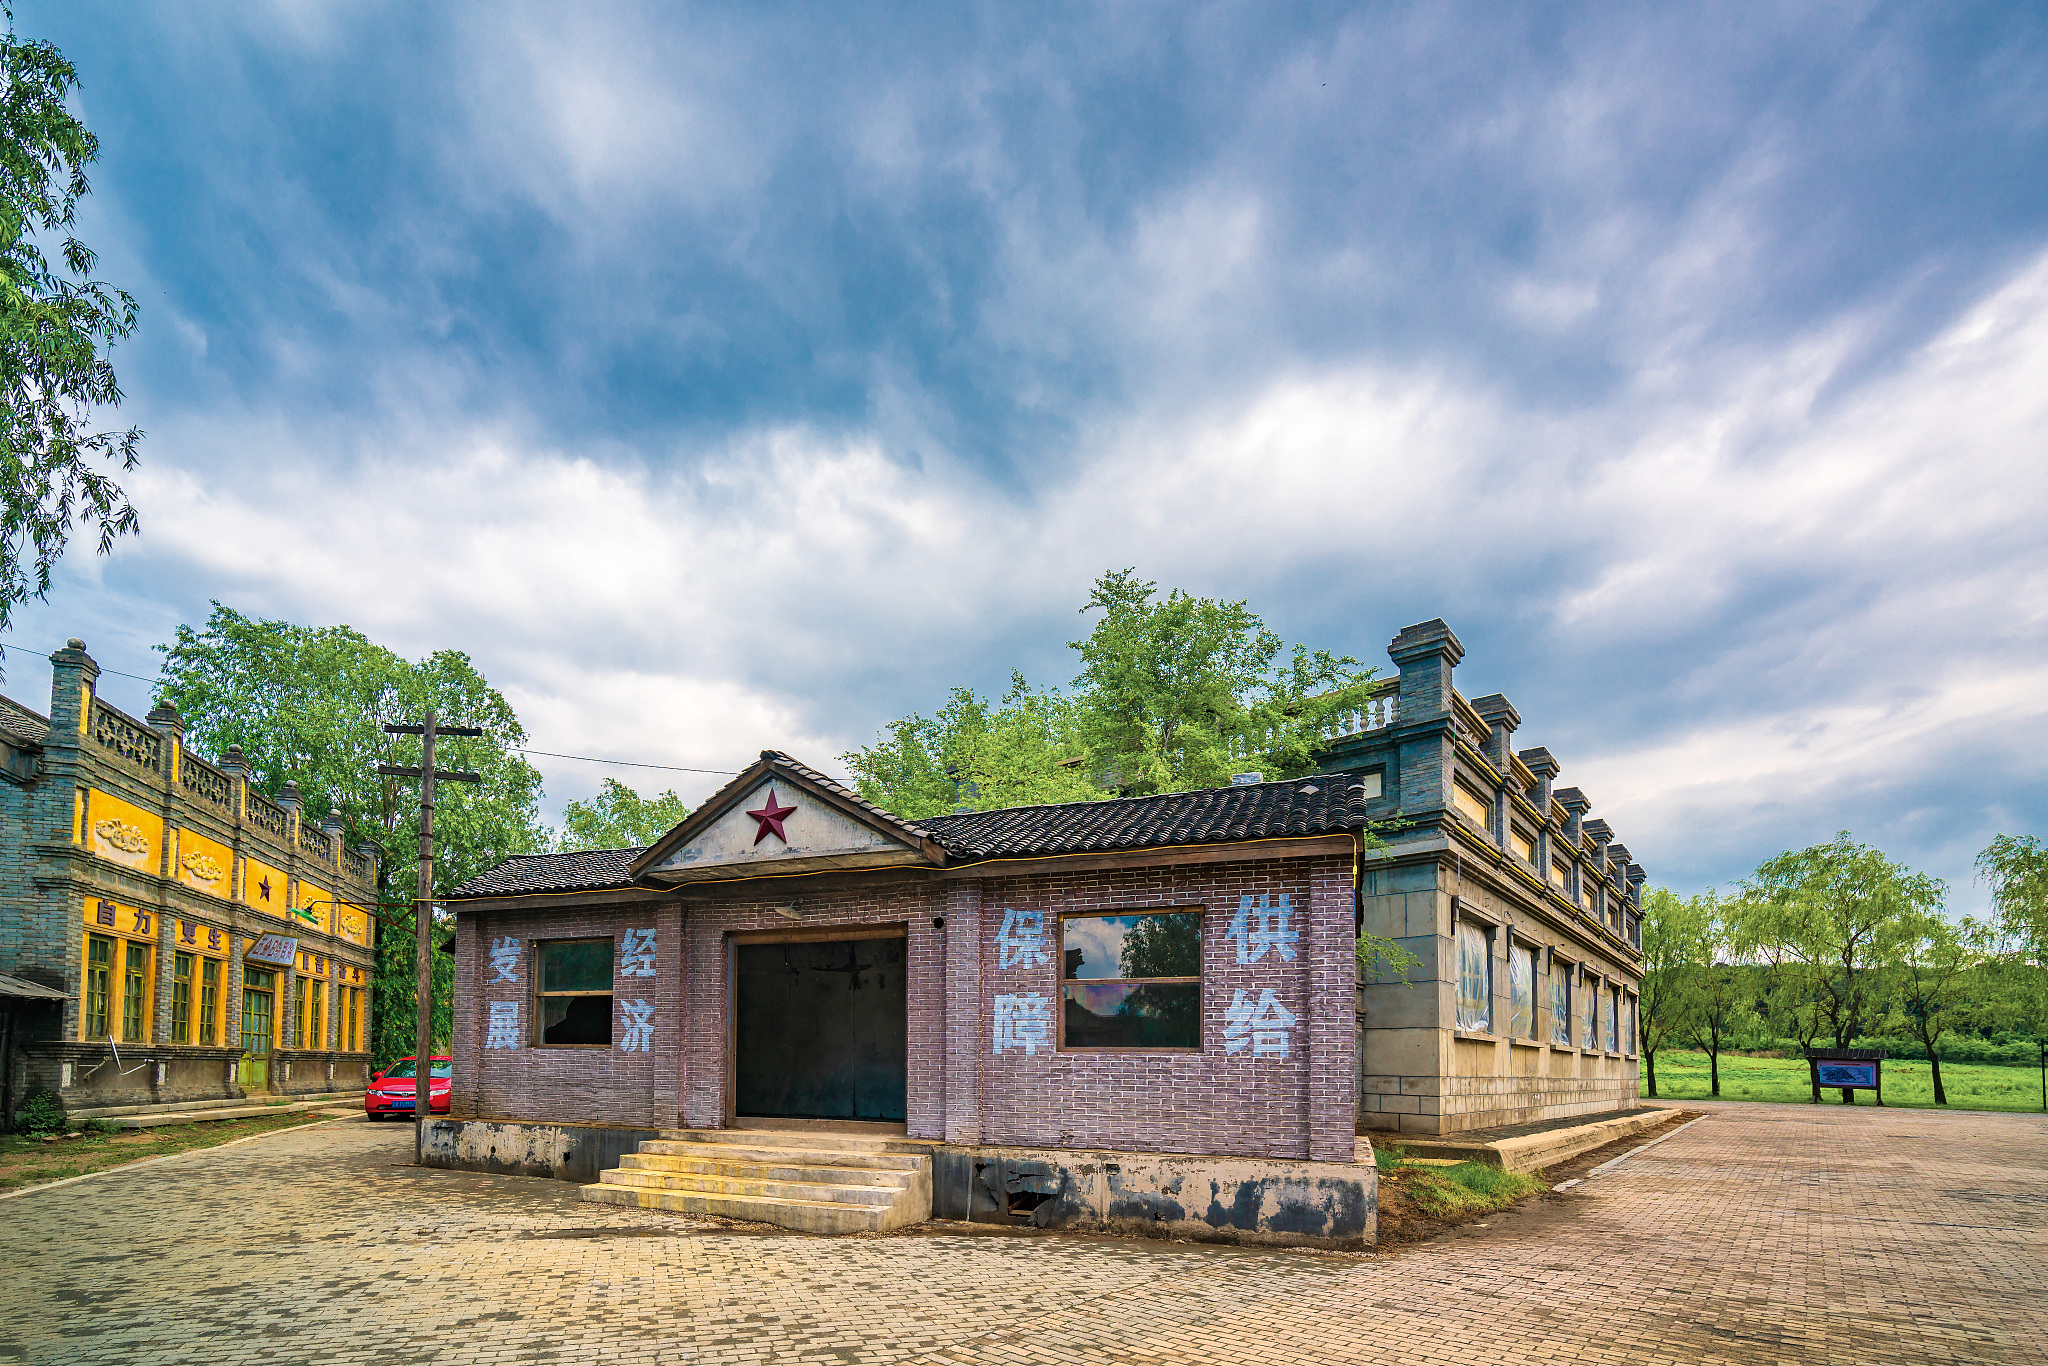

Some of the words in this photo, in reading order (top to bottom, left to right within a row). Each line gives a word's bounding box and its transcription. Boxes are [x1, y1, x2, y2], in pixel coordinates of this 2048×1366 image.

[97, 900, 222, 951] 自力更生
[992, 908, 1050, 1055] 保障
[1222, 893, 1300, 1058] 供给
[484, 936, 521, 1050] 发展
[620, 928, 657, 1052] 经济
